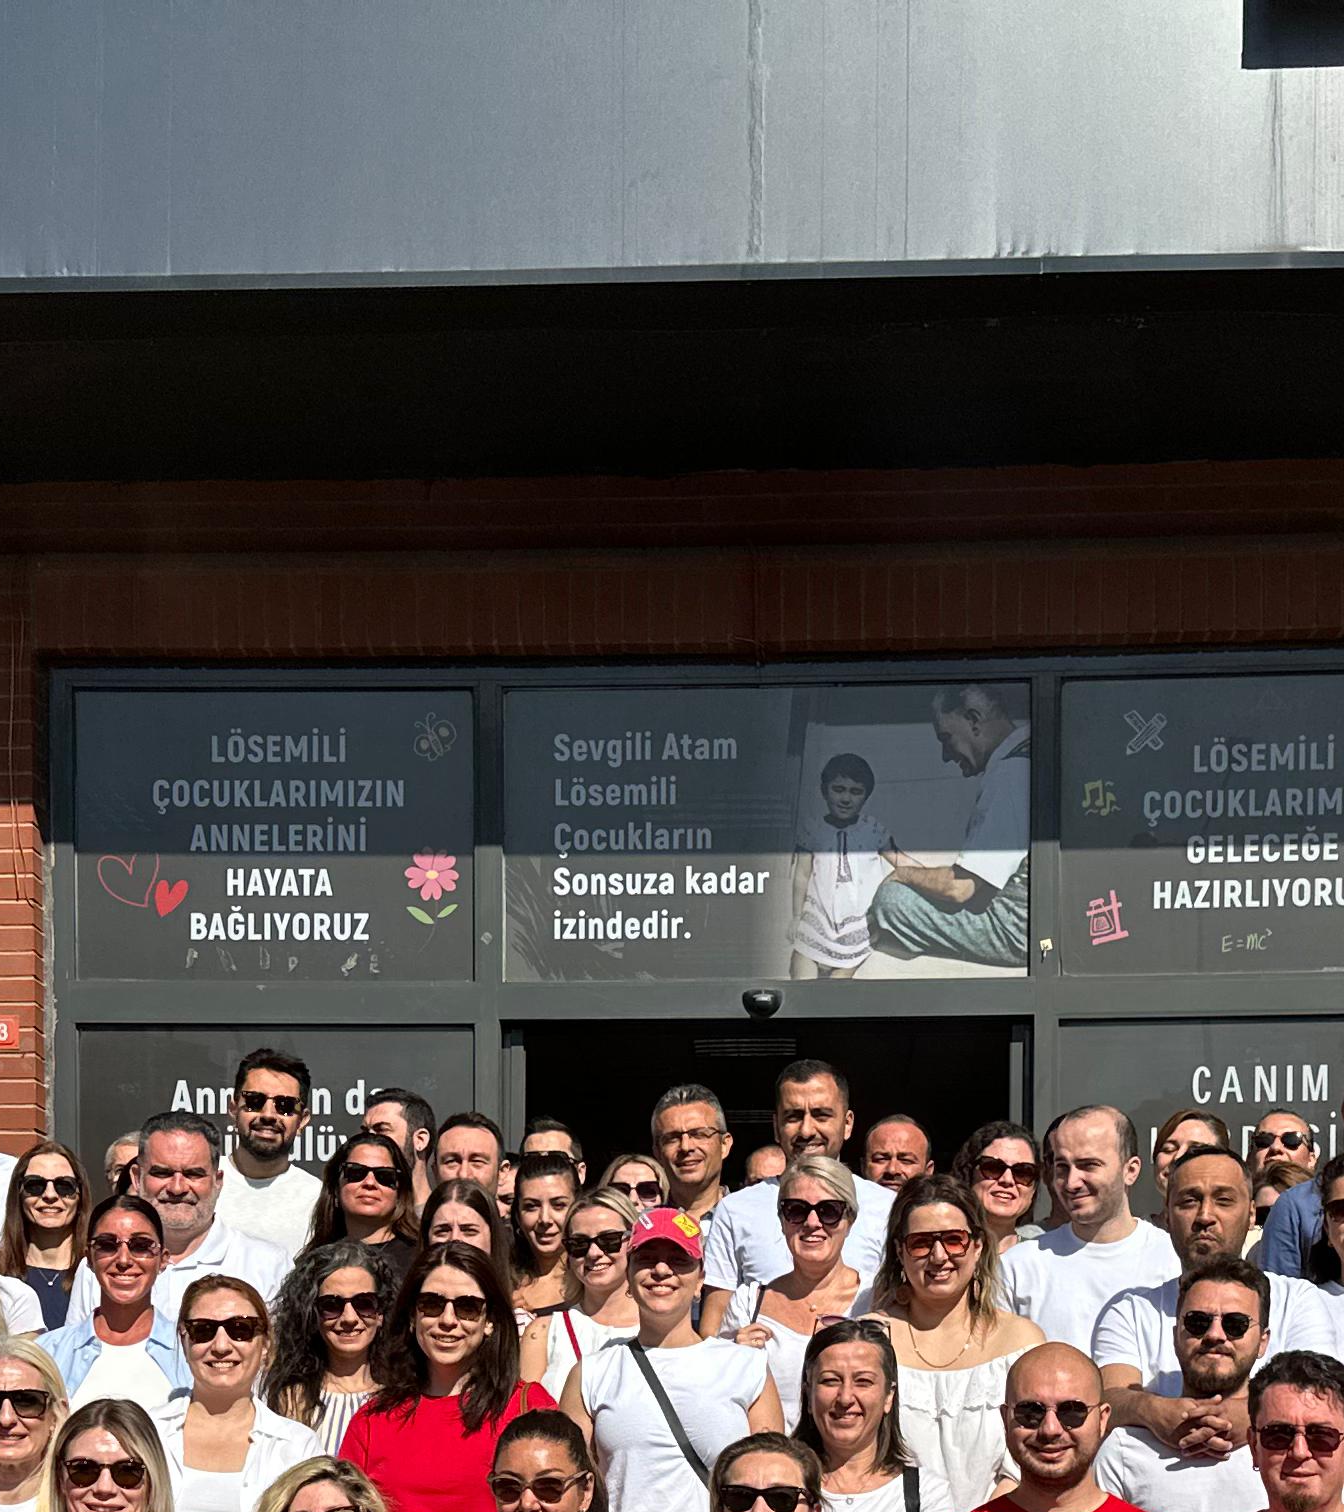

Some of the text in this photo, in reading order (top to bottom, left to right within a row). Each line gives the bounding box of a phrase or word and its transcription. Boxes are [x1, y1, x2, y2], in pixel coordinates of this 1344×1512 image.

[210, 728, 347, 765] LÖSEMİLİ
[553, 731, 738, 768] Sevgili Atam
[1192, 734, 1335, 774] LÖSEMİLİ
[152, 778, 406, 816] ÇOCUKLARIMIZIN
[554, 775, 678, 806] Lösemili
[189, 815, 367, 853] ANNELERİNİ
[554, 820, 713, 858] Çocukların
[1186, 824, 1340, 865] GELECEĞE
[226, 868, 334, 898] HAYATA
[553, 864, 770, 896] Sonsuza kadar
[189, 903, 370, 942] BAĞLIYORUZ
[553, 909, 692, 941] izindedir.
[1191, 1063, 1330, 1105] CANIM
